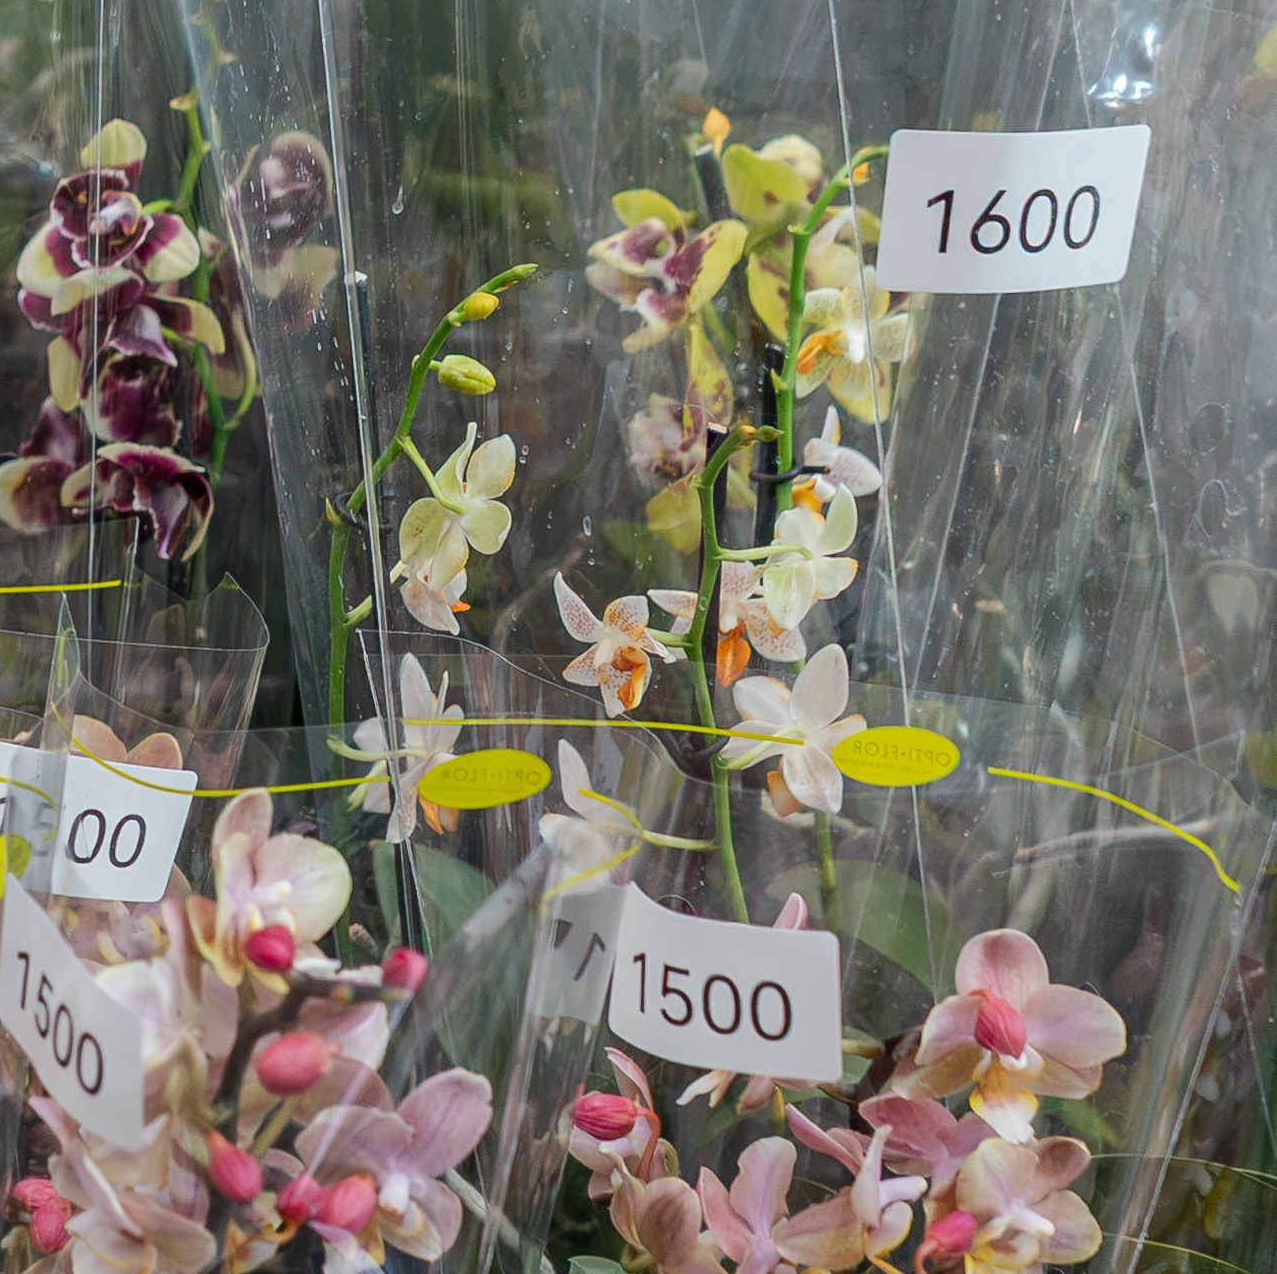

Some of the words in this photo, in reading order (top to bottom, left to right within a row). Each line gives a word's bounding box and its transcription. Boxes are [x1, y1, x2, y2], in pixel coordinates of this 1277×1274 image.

[926, 185, 1101, 254] 1600
[18, 951, 104, 1096] 1500
[633, 952, 792, 1041] 1500
